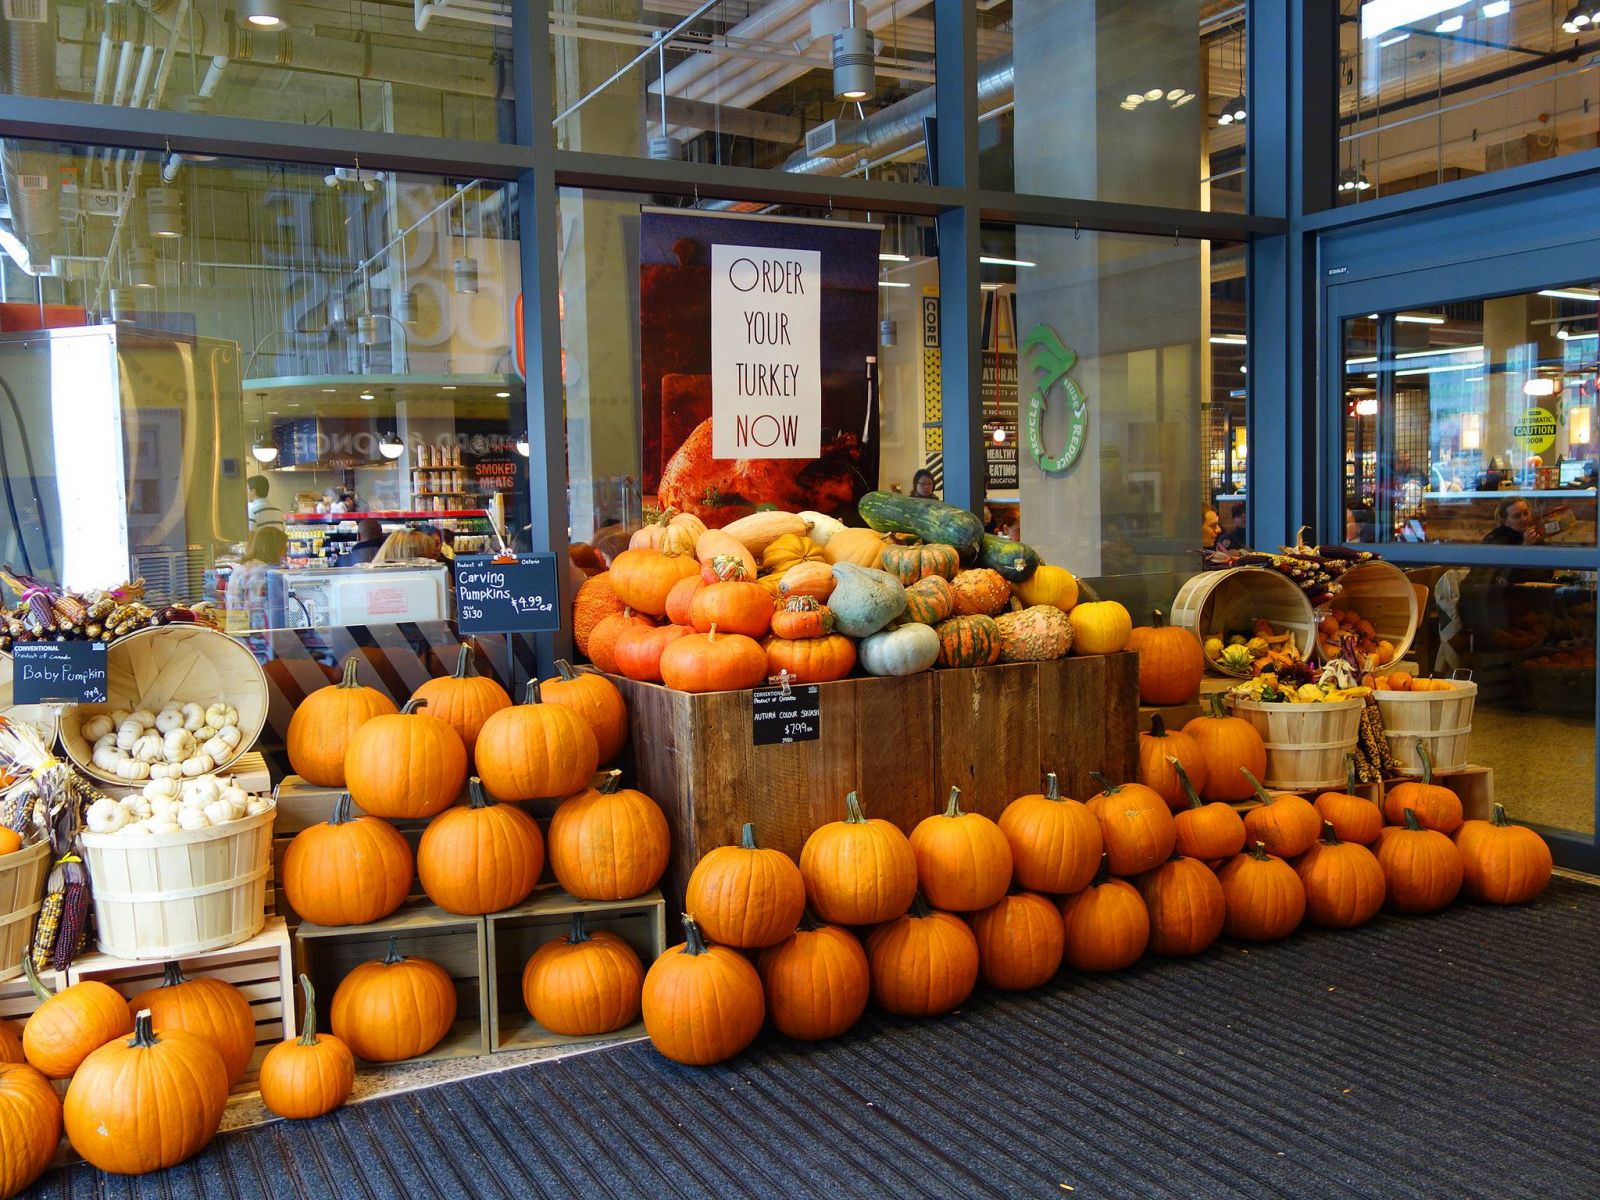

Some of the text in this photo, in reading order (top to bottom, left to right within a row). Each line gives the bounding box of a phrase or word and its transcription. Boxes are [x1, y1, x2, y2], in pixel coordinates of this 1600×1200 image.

[728, 257, 805, 295] ORDER
[744, 311, 791, 345] YOUR
[926, 301, 936, 343] CORE
[735, 363, 799, 397] TURKEY
[982, 367, 1018, 381] ATURAL
[1063, 378, 1079, 409] REUSE
[736, 414, 799, 448] NOW
[1029, 398, 1040, 455] RECYCLE
[1516, 426, 1554, 435] CAUTION
[986, 449, 1016, 459] HEALTHY
[1056, 424, 1082, 469] REDUCE
[475, 463, 517, 475] SMOKED
[479, 476, 514, 488] MEATS
[988, 464, 1016, 477] EATING
[459, 571, 505, 588] Carving
[23, 663, 105, 684] Baby Pumpkin
